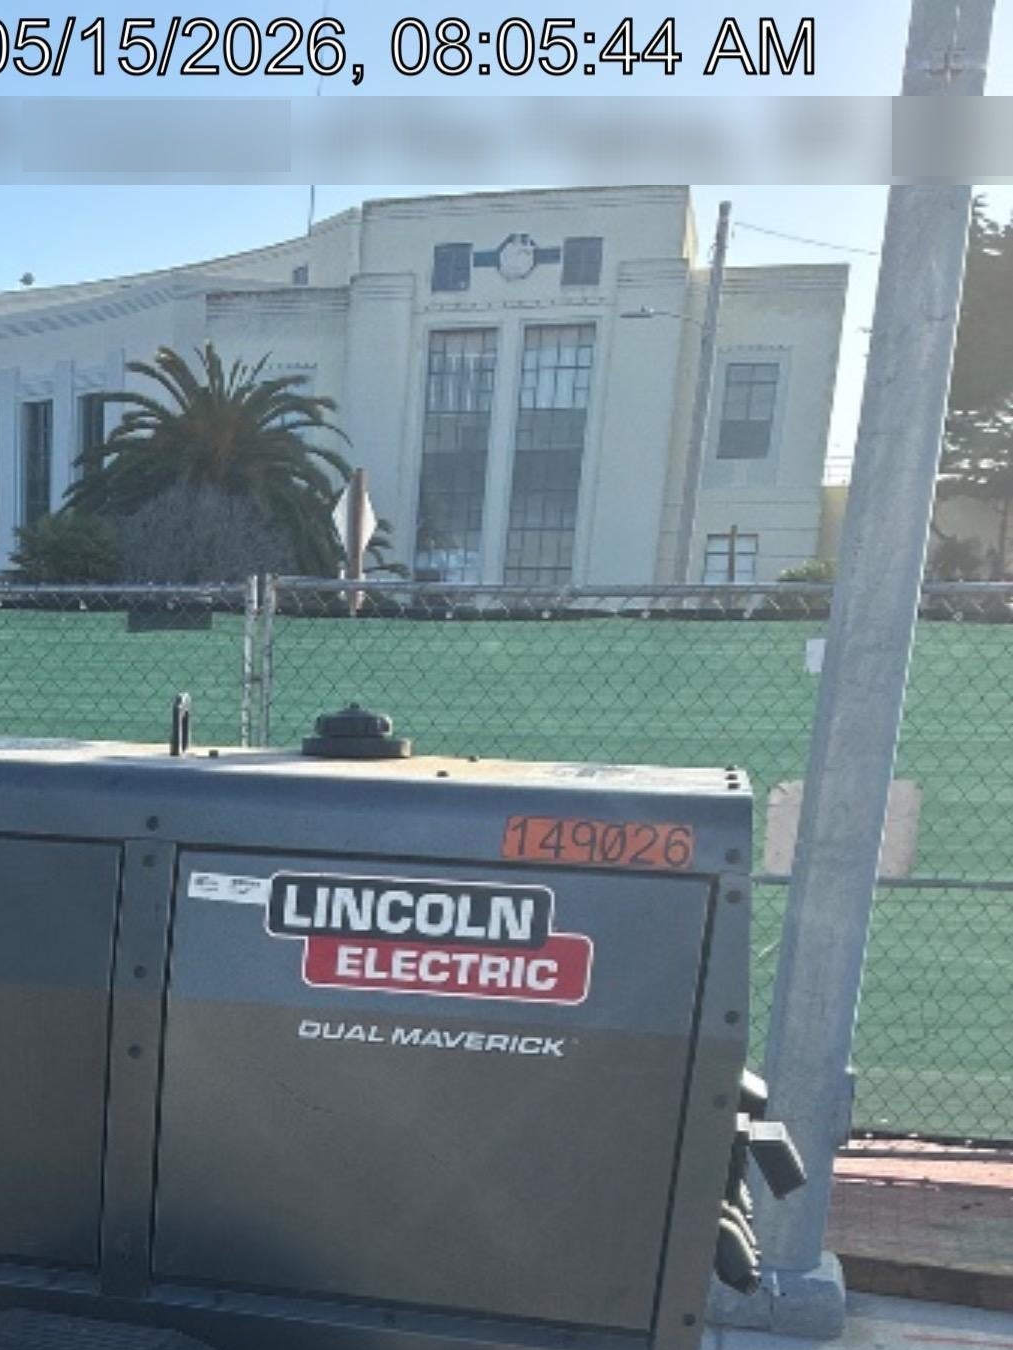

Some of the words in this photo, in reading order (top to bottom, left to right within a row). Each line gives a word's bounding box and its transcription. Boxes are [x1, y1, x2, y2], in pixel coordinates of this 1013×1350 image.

[511, 818, 690, 867] 149026
[283, 884, 534, 940] LINCOLN
[334, 945, 559, 991] ELECTRIC
[298, 1019, 385, 1042] DUAL
[391, 1026, 565, 1057] MAVERICK
